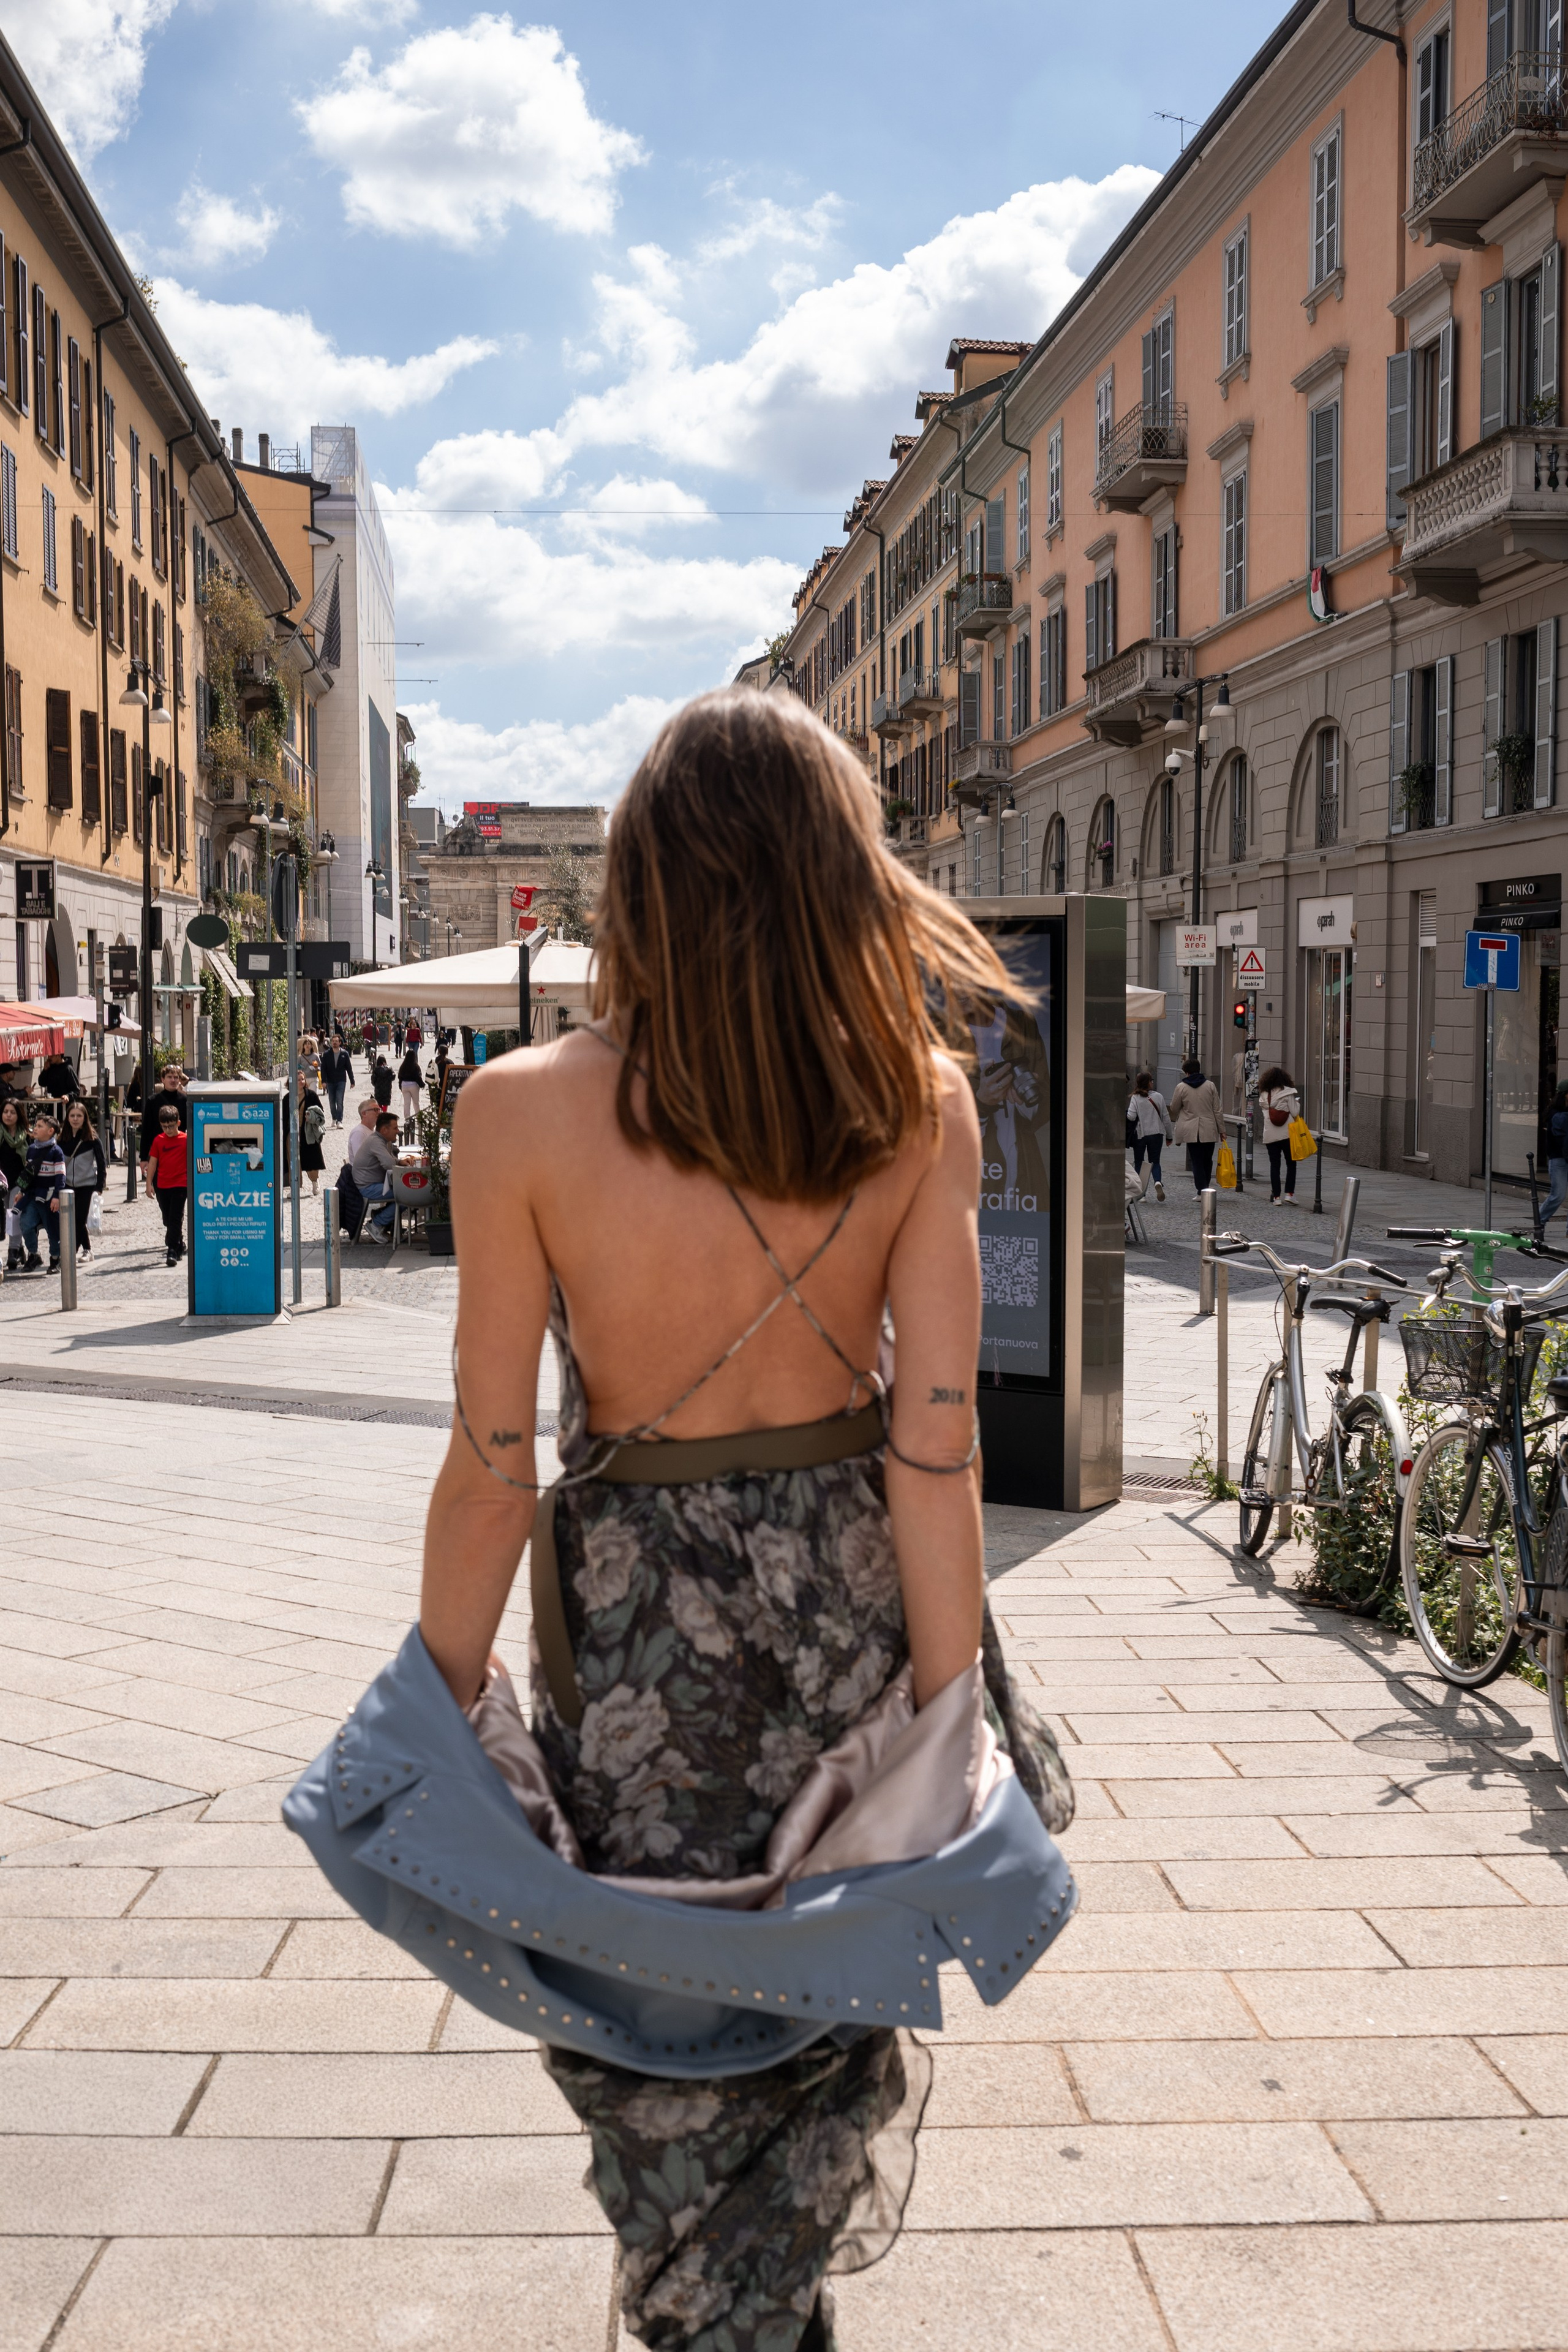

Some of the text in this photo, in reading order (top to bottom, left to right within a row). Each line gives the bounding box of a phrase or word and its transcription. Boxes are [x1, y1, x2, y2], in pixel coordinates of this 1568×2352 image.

[514, 889, 527, 898] Brera
[1507, 883, 1534, 897] PINKO
[1501, 916, 1523, 927] PINKO
[7, 1036, 44, 1060] Ristorante
[198, 1191, 271, 1209] GRAZIE
[978, 1187, 1037, 1212] rafia
